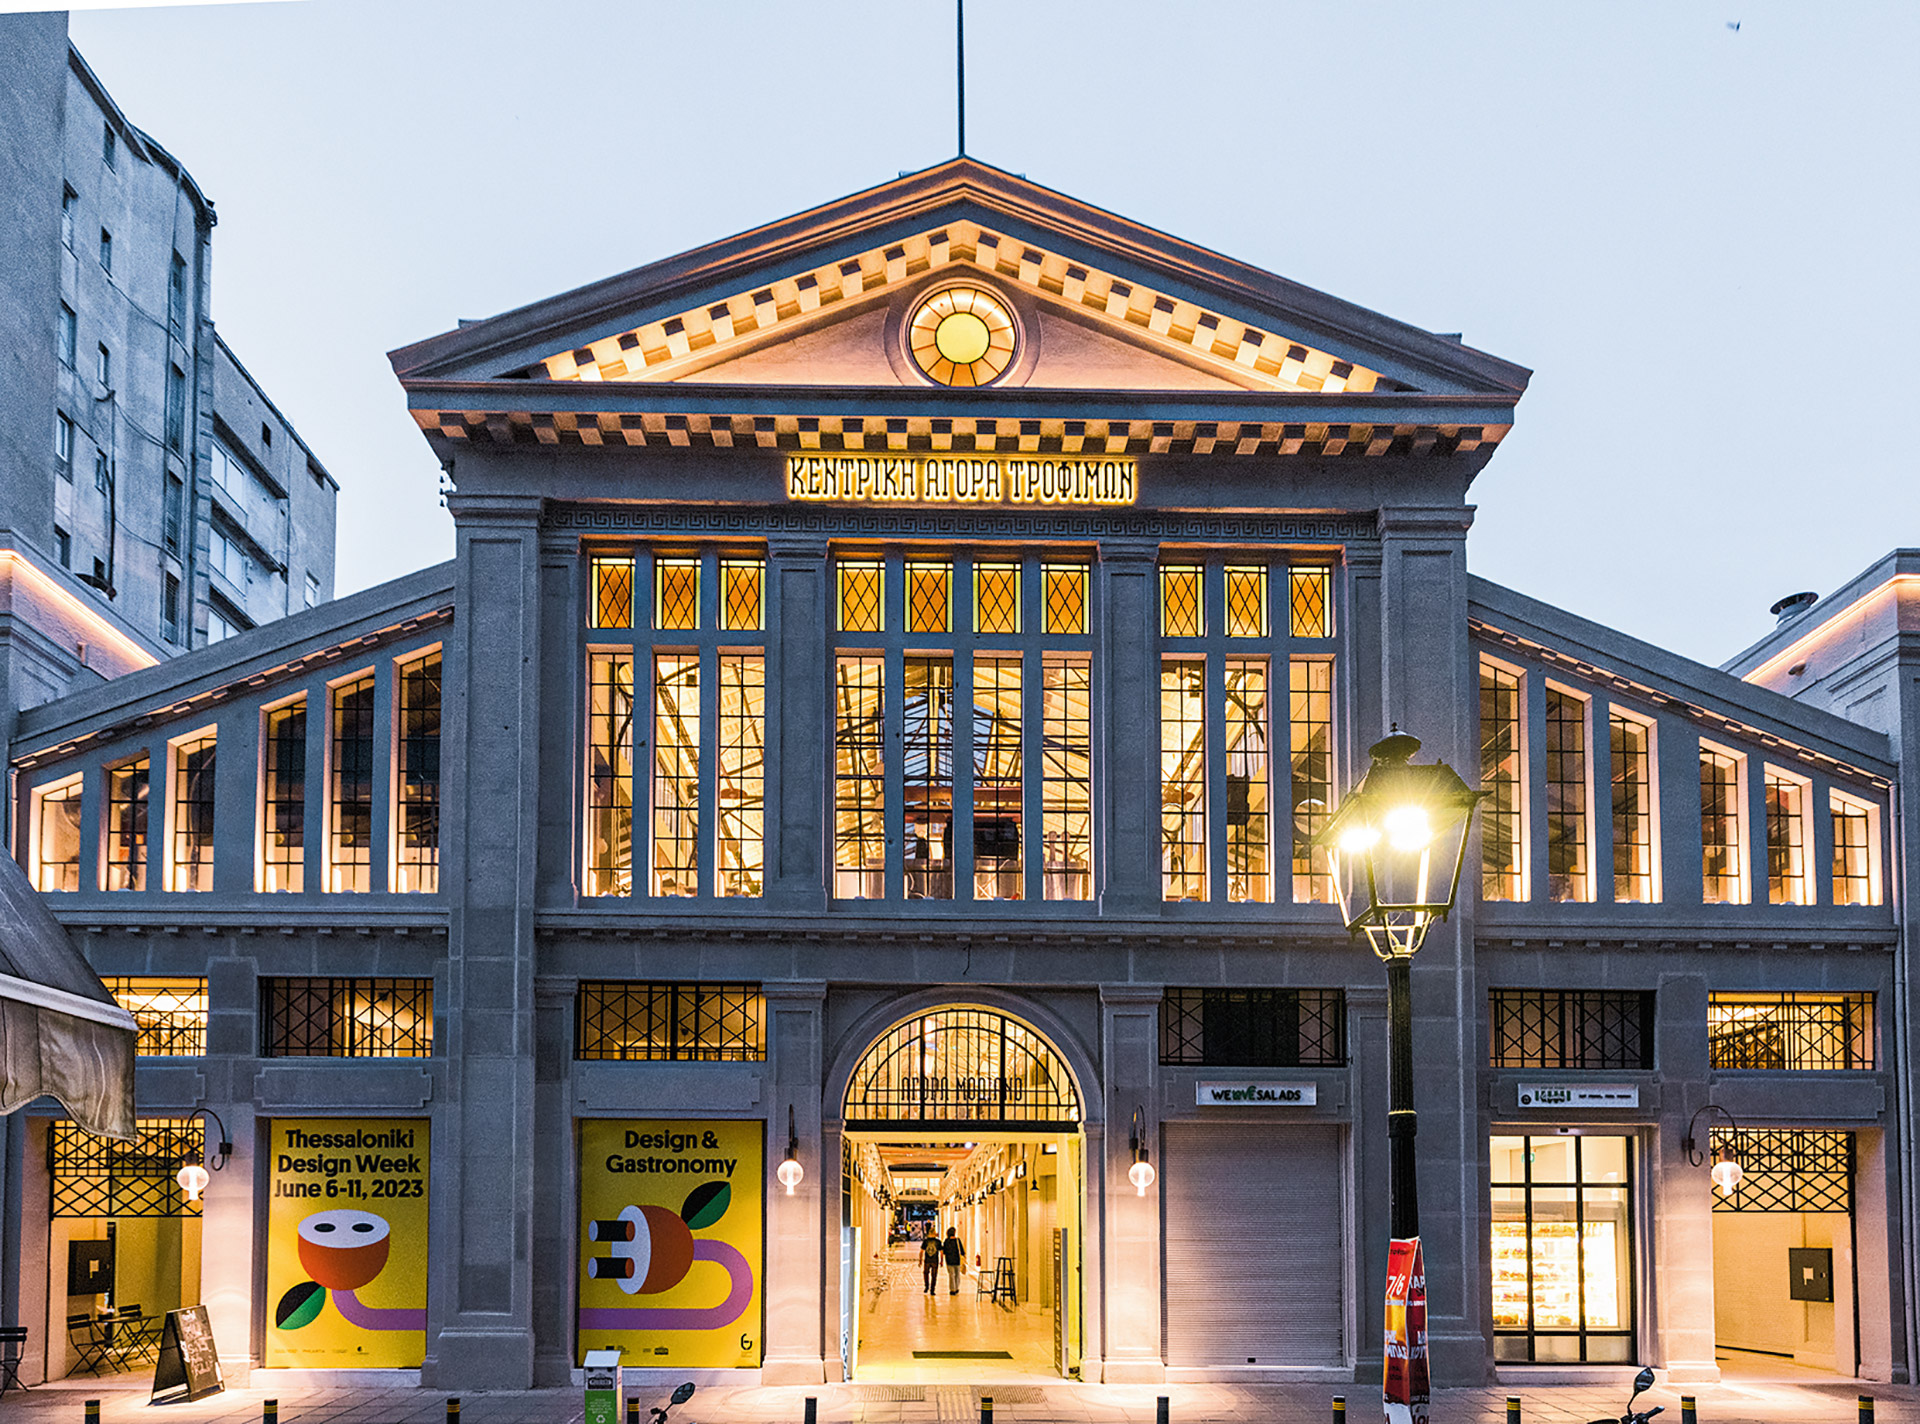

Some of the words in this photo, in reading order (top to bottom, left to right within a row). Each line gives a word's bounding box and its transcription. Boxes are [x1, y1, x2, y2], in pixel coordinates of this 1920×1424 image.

[790, 457, 916, 496] ΚΕΝΤΡΙΚΗ
[925, 459, 1000, 497] ΑΓΟΡΑ
[1009, 460, 1134, 500] ΤΡΟΦΙΜΩΝ
[1256, 1089, 1302, 1101] SALADS
[285, 1128, 414, 1148] Thessaloniki
[625, 1129, 698, 1153] Design
[701, 1130, 720, 1149] &
[278, 1153, 351, 1178] Design
[355, 1154, 421, 1173] Week
[605, 1154, 738, 1178] Gastronomy
[274, 1179, 321, 1198] June
[326, 1179, 368, 1201] 6-11,
[371, 1179, 424, 1198] 2023
[1387, 1273, 1406, 1298] 7/6
